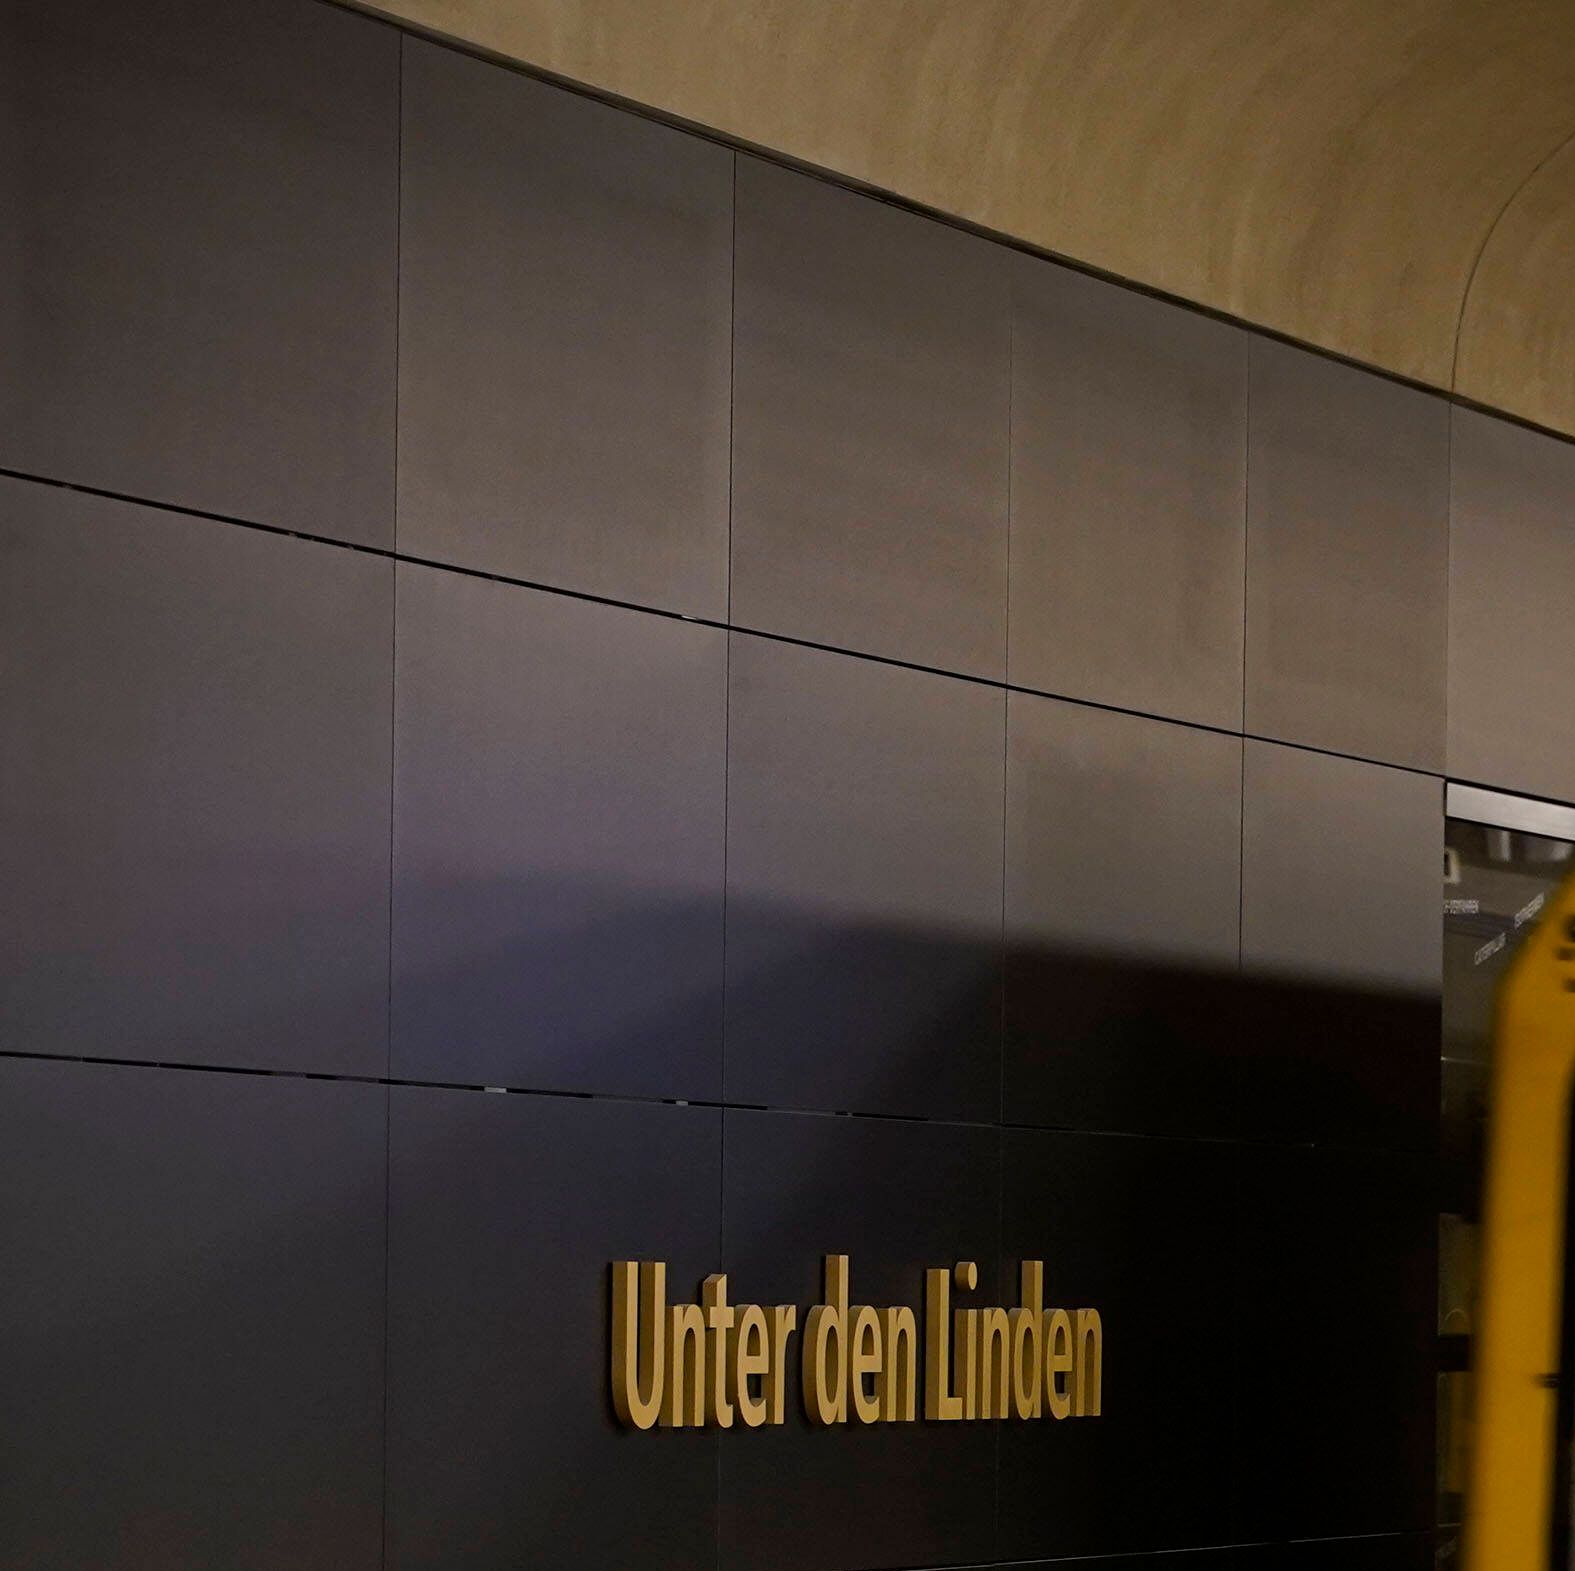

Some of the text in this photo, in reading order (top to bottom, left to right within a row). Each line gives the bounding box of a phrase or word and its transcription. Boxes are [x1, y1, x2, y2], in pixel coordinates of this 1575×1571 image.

[611, 1254, 1102, 1430] Unter den Linden
